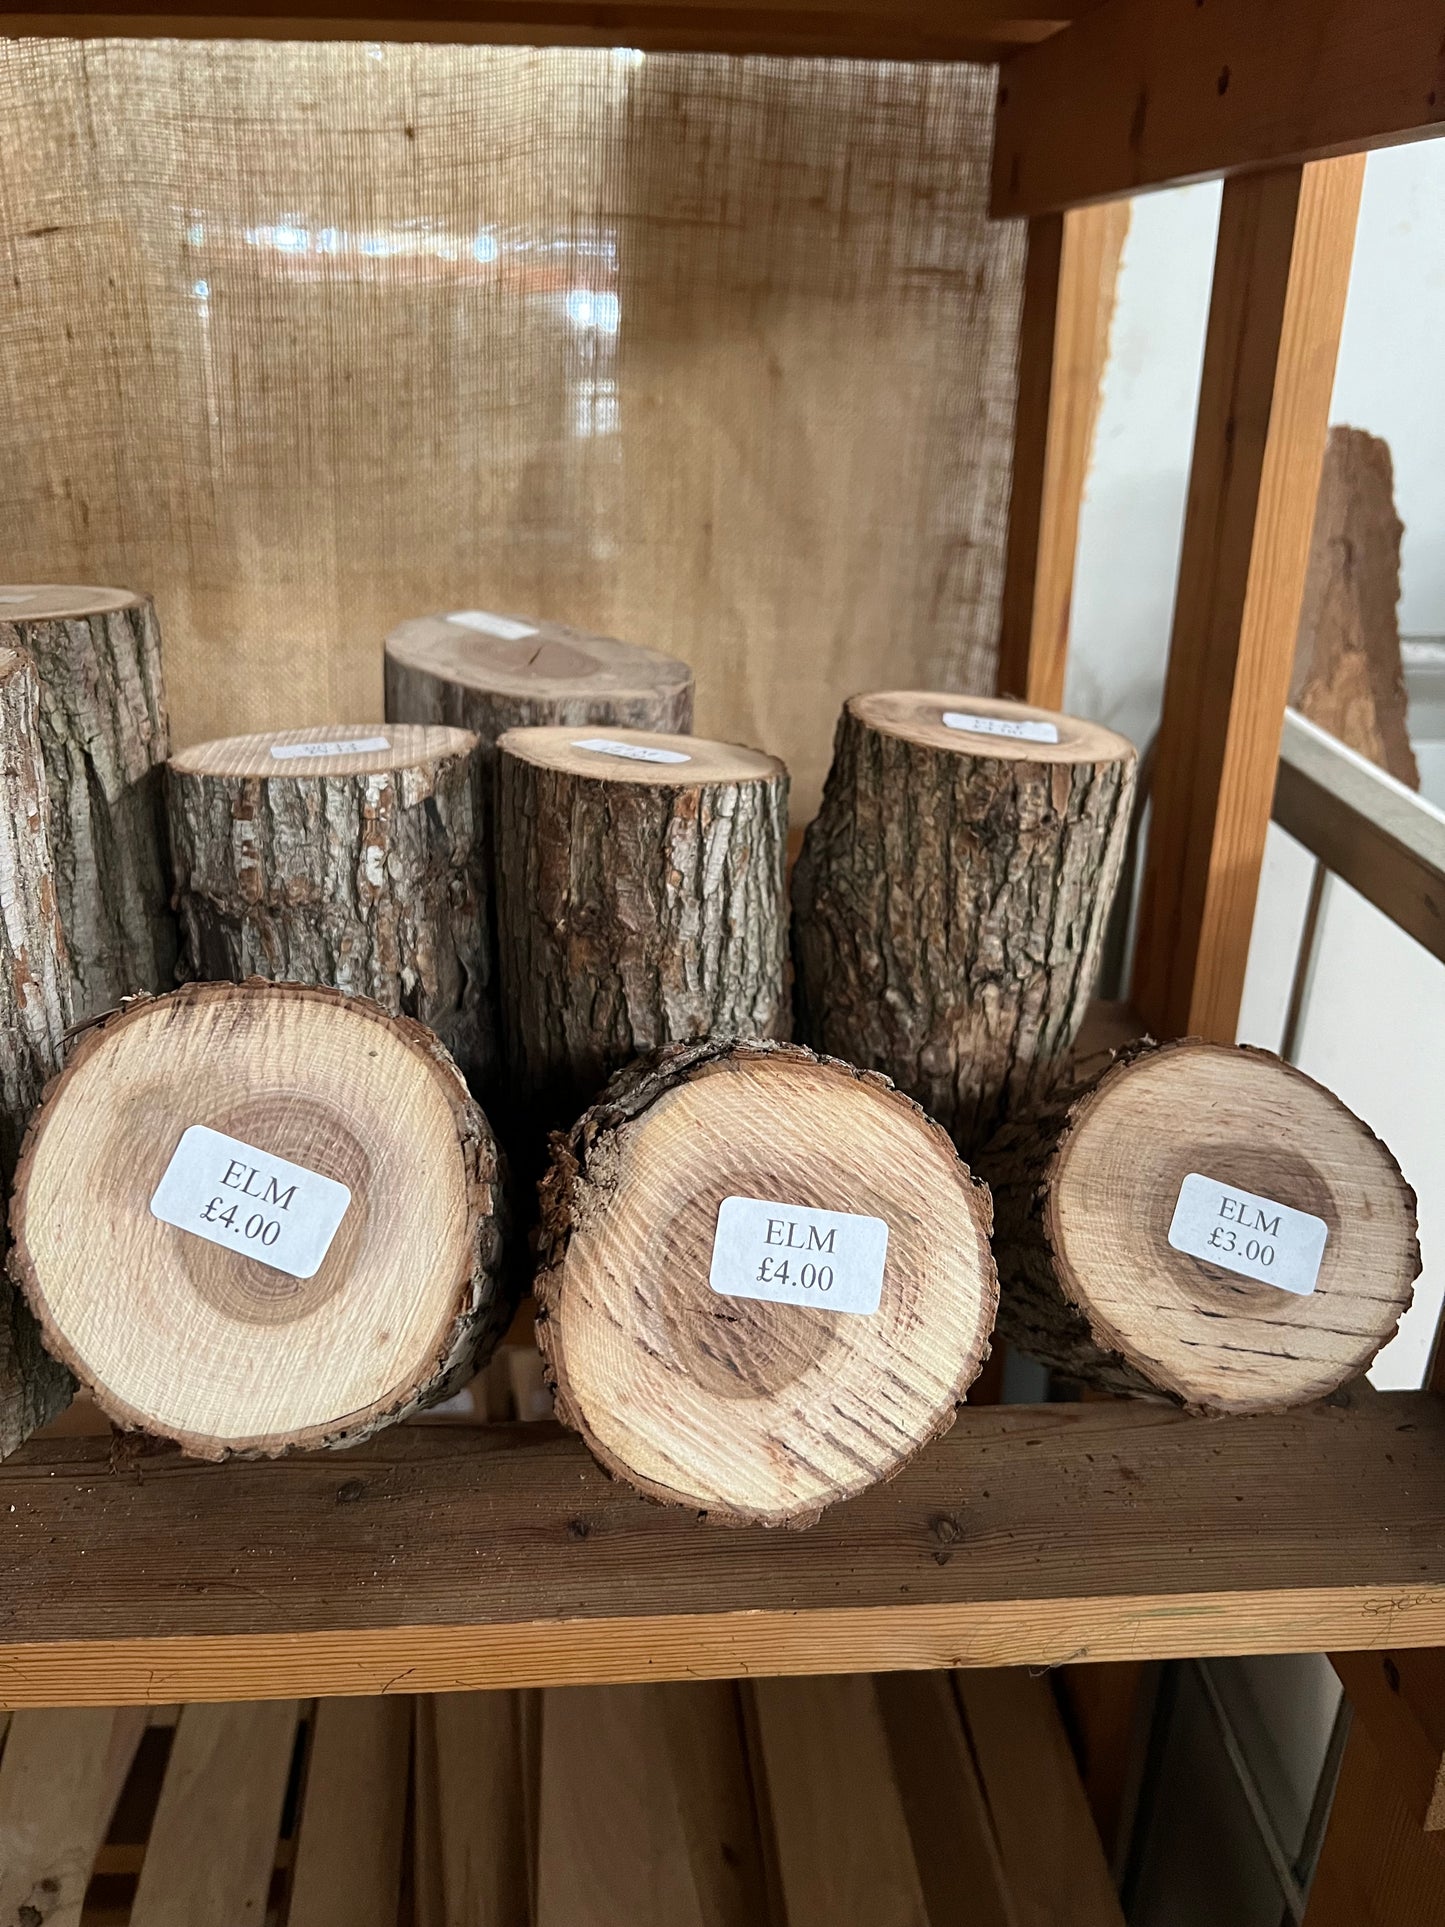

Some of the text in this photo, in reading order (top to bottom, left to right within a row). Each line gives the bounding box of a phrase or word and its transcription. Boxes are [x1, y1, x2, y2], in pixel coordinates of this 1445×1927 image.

[219, 1159, 300, 1211] ELM
[199, 1196, 281, 1246] £4.00
[763, 1218, 838, 1254] ELM
[1216, 1195, 1283, 1238] ELM
[1206, 1226, 1275, 1266] £3.00
[756, 1256, 834, 1292] £4.00
